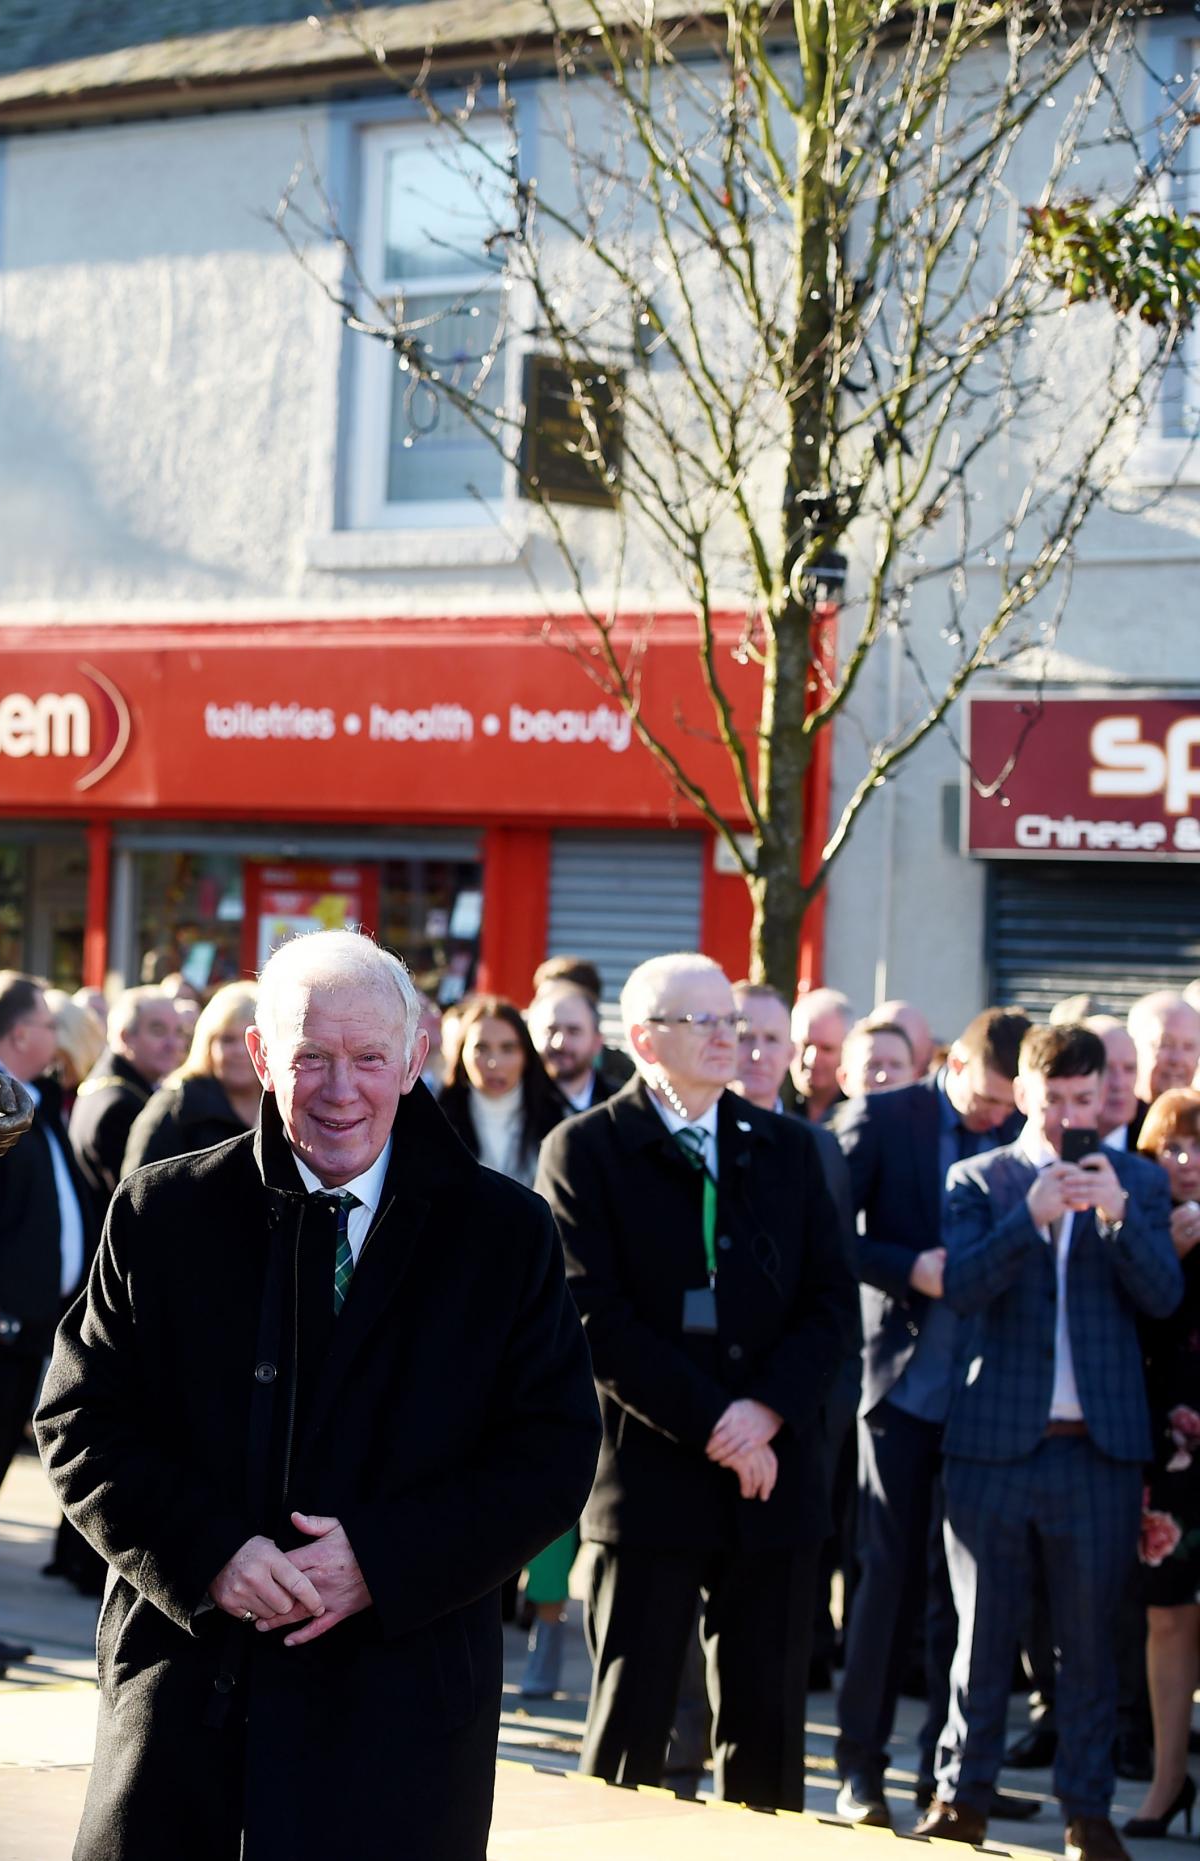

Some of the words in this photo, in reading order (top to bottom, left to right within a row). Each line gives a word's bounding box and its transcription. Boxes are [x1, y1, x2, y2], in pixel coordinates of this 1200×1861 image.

[204, 701, 336, 740] toiletries
[369, 703, 474, 741] health
[509, 703, 632, 752] beauty
[1015, 813, 1167, 849] Chinese
